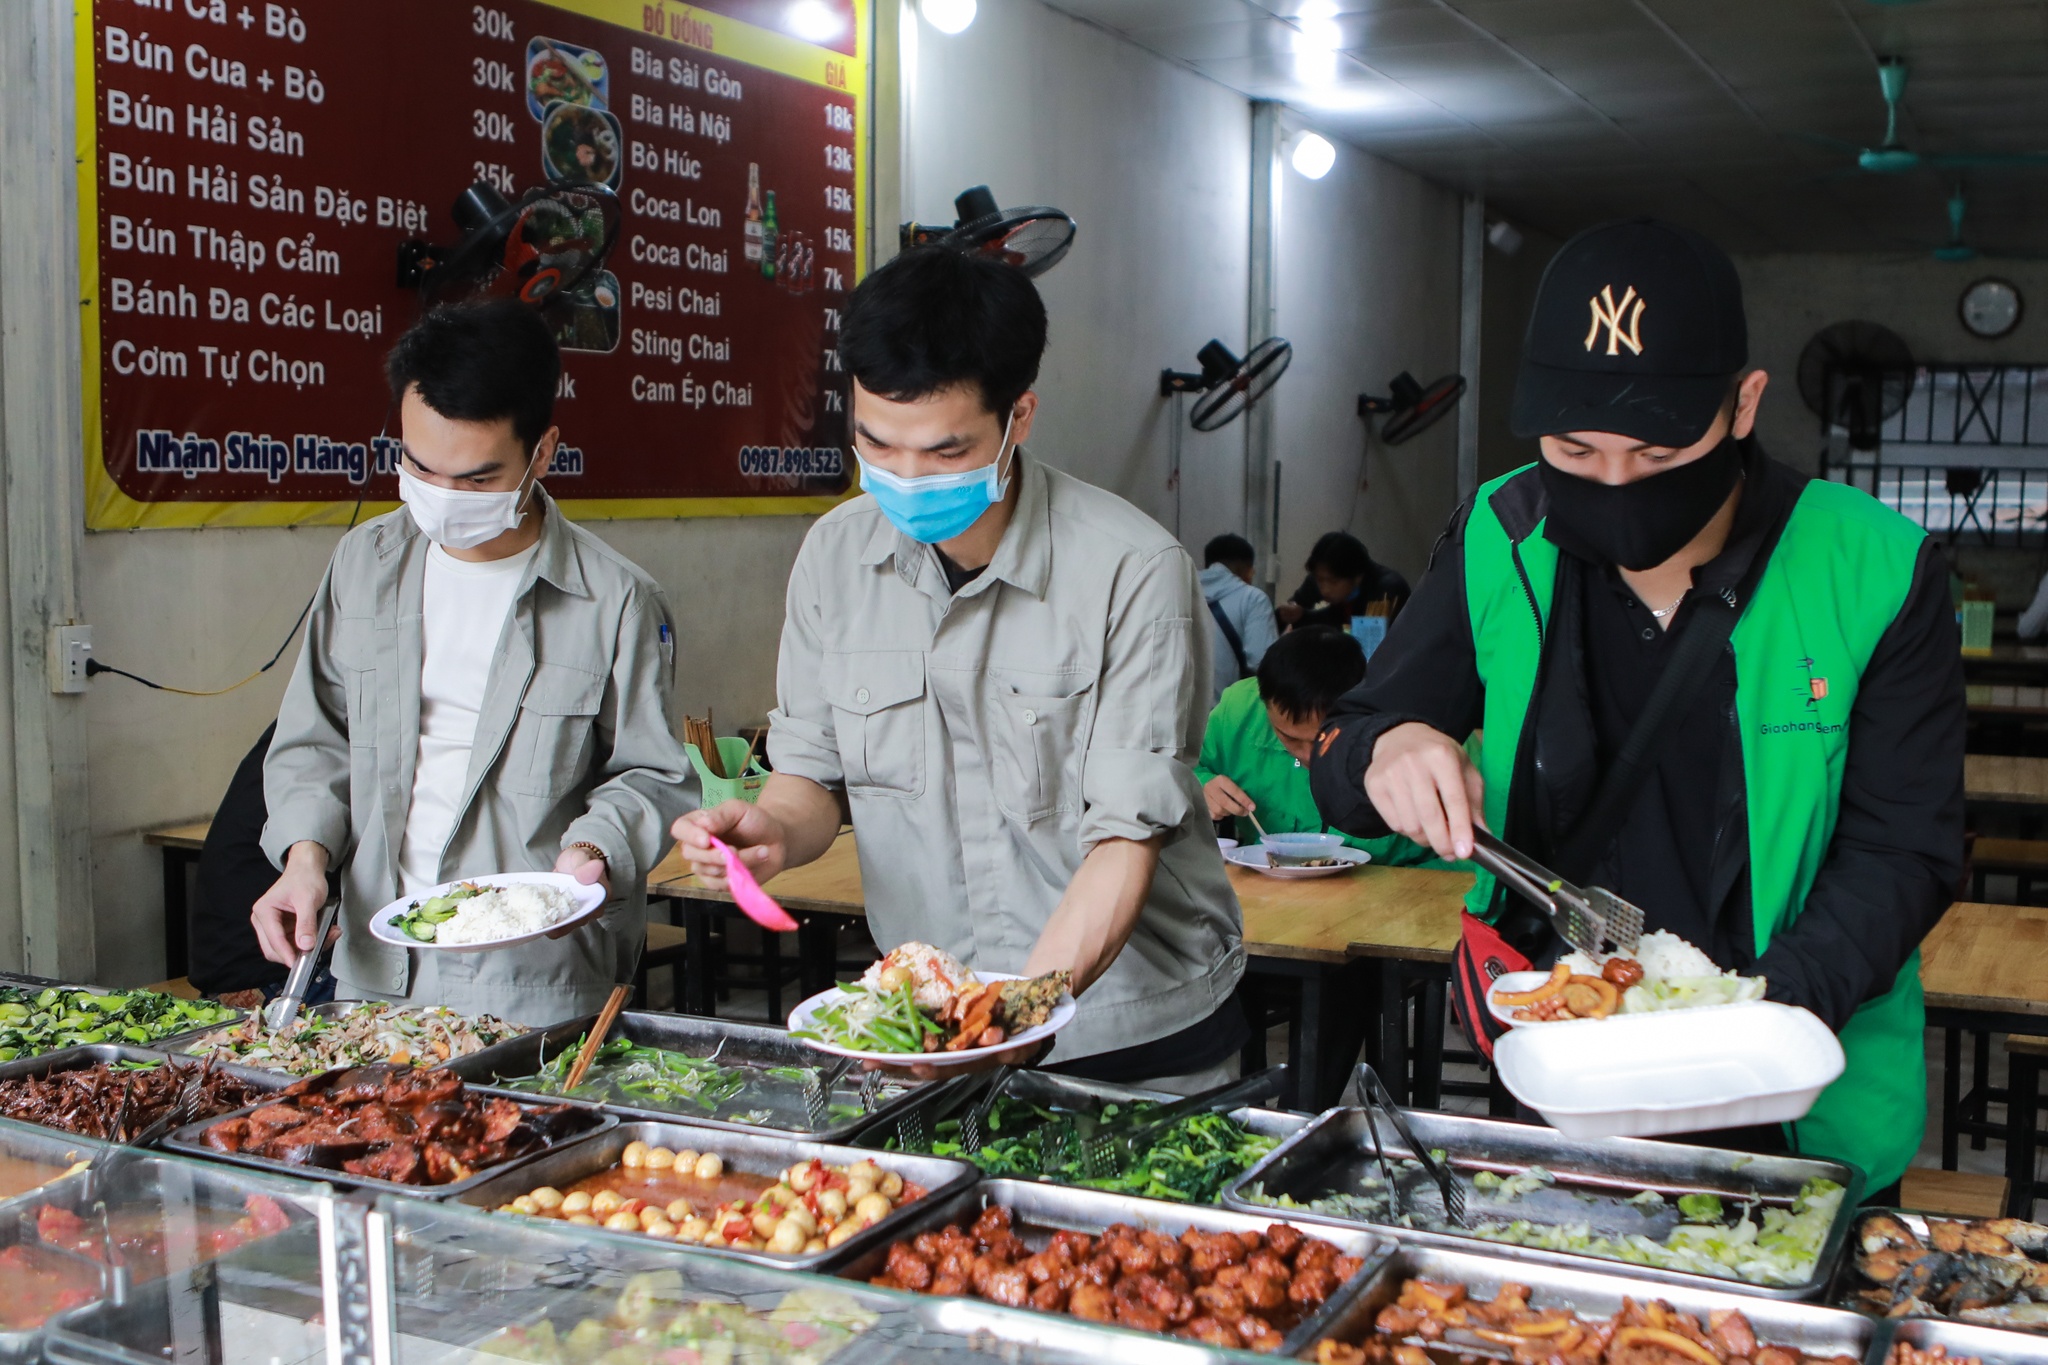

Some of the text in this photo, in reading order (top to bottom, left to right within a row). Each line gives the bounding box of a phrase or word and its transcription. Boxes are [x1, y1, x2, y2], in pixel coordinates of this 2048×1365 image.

[236, 5, 256, 30] +
[265, 2, 307, 44] Bò
[472, 5, 515, 42] 30k
[671, 7, 713, 50] UỐNG
[105, 25, 325, 104] Bún Cua + Bò
[472, 57, 515, 93] 30k
[631, 46, 742, 101] Bia Sài Gòn
[107, 88, 304, 157] Bún Hải Sản
[472, 109, 515, 144] 30k
[631, 93, 731, 145] Bia Hà Nội
[824, 103, 853, 131] 18k
[631, 140, 702, 179] Bò Húc
[824, 144, 852, 171] 13k
[108, 151, 428, 236] Bún Hải Sản Đặc Biệt
[472, 161, 515, 194] 35k
[631, 187, 721, 228] Coca Lon
[824, 185, 852, 211] 15k
[110, 214, 340, 275] Bún Thập Cẩm
[631, 234, 728, 273] Coca Chai
[824, 226, 852, 251] 15k
[631, 281, 720, 316] Pesi Chai
[824, 267, 843, 291] 7k
[111, 277, 383, 340] Bánh Đa Các Loại
[824, 308, 842, 331] 7k
[1583, 283, 1647, 356] NY
[112, 339, 326, 390] Cơm Tự Chọn
[631, 328, 730, 364] Sting Chai
[824, 349, 843, 372] 7k
[631, 371, 753, 410] Cam Ép Chai
[824, 390, 843, 412] 7k
[136, 429, 221, 479] Nhận
[225, 430, 290, 484] Ship
[293, 433, 368, 485] Hàng
[738, 445, 843, 476] 0987.898.523
